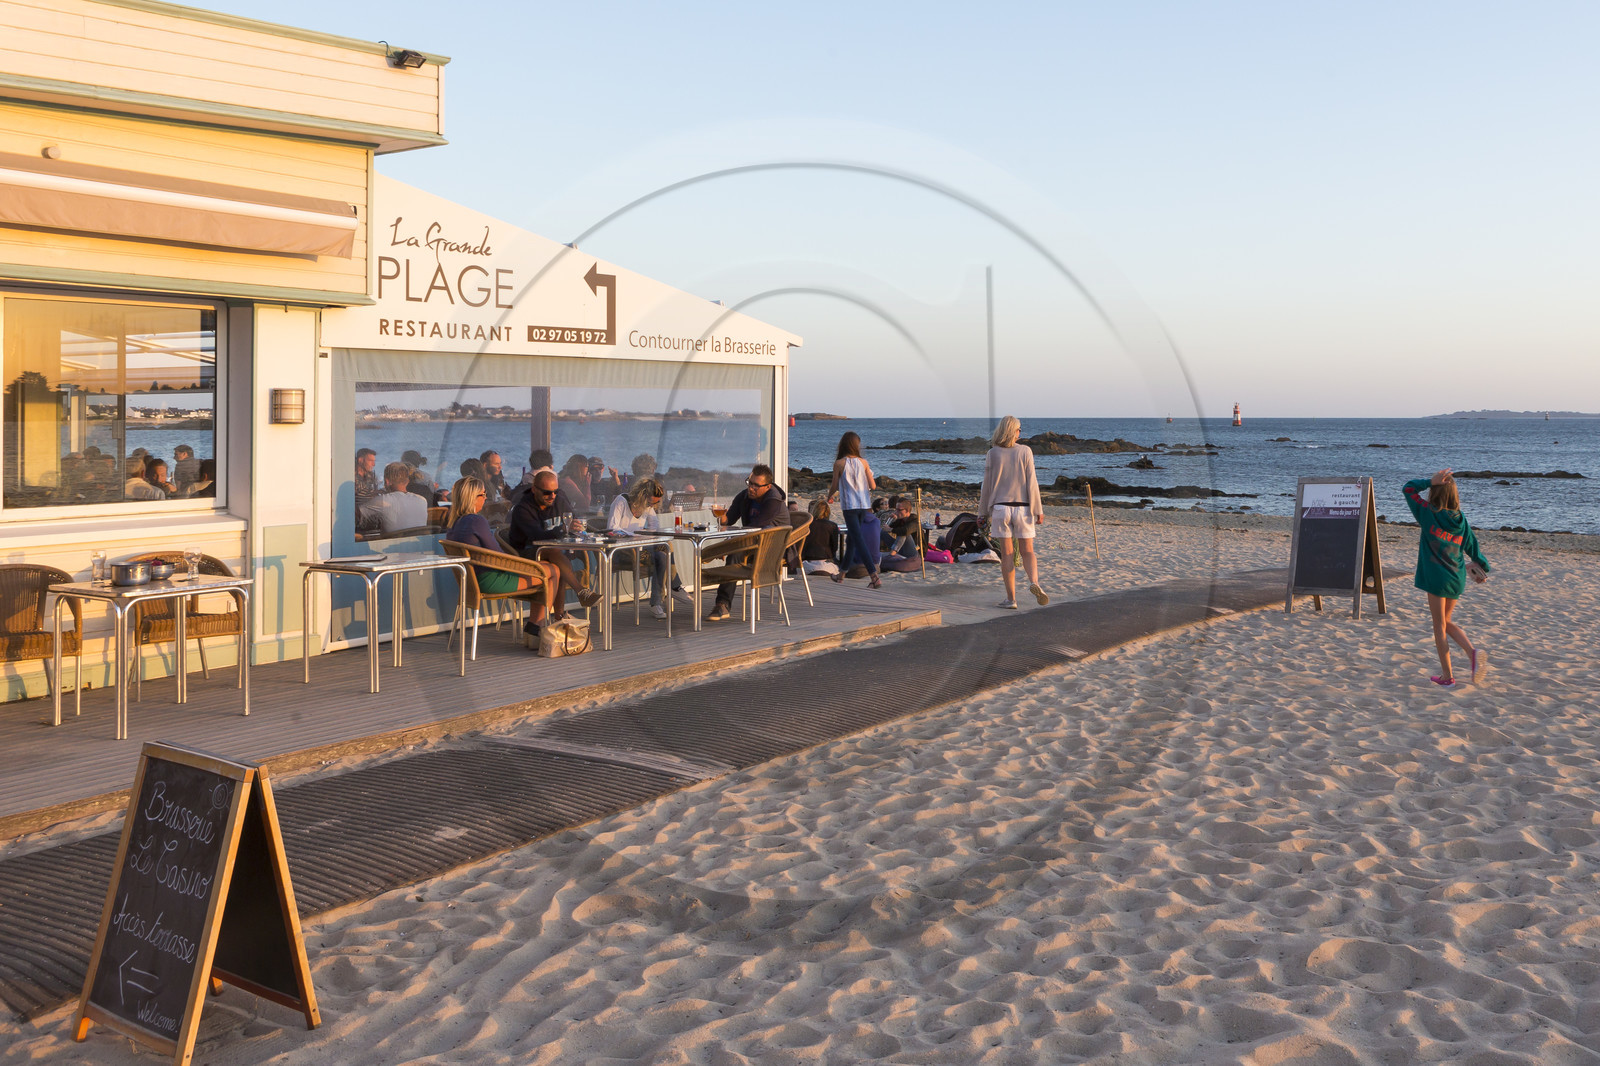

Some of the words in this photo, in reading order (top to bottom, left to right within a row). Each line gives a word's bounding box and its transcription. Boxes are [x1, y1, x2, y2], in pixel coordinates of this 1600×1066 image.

[390, 217, 420, 247] La
[425, 221, 492, 262] Grande
[378, 255, 513, 309] PLAGE
[379, 318, 512, 341] RESTAURANT
[532, 328, 547, 341] 02
[549, 329, 562, 341] 97
[564, 329, 577, 342] 05
[628, 330, 708, 351] Contourner
[711, 335, 721, 352] la
[725, 336, 776, 356] Brasserie
[145, 781, 215, 844] Brasserie
[131, 835, 154, 874] Le
[156, 840, 212, 899] Casino
